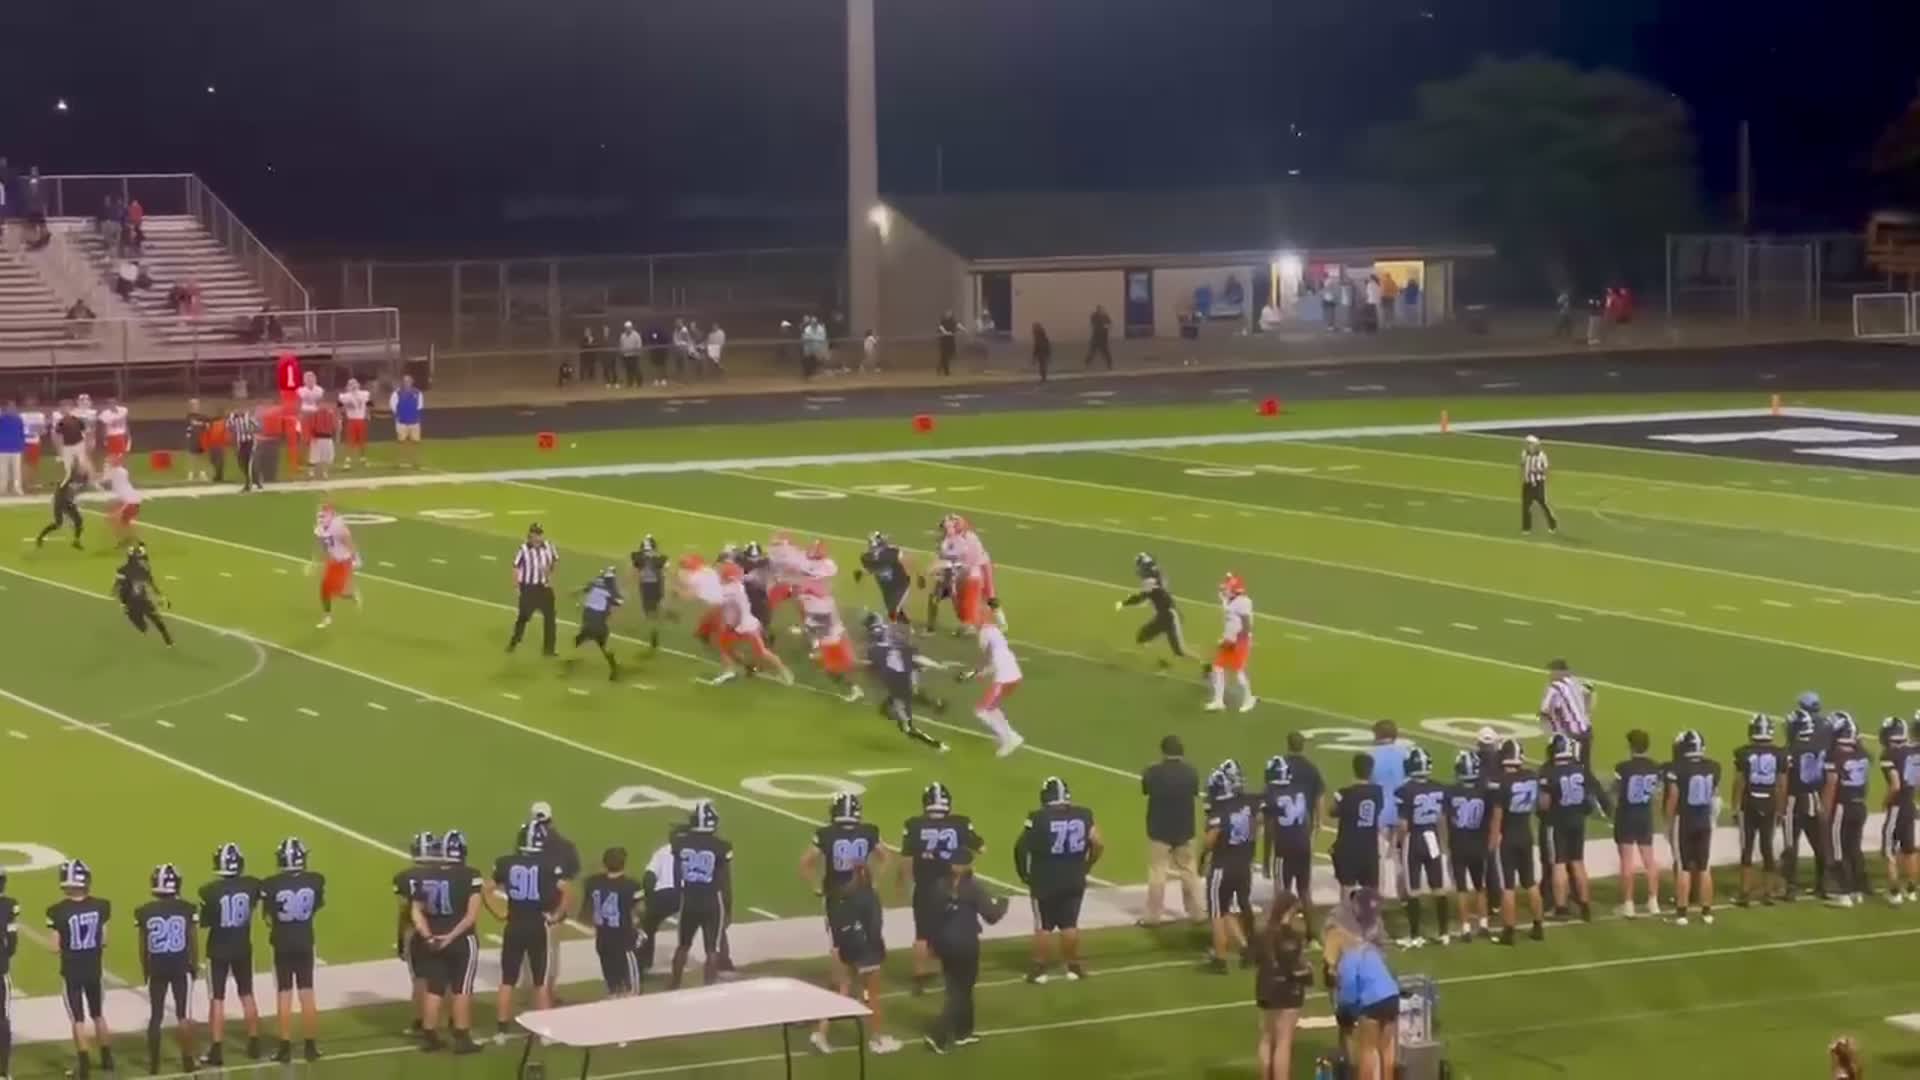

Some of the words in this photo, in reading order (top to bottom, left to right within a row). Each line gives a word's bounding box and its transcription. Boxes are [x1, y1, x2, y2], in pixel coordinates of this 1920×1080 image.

[1049, 819, 1087, 855] 72
[509, 864, 541, 901] 91
[67, 911, 100, 950] 17
[146, 915, 186, 953] 28
